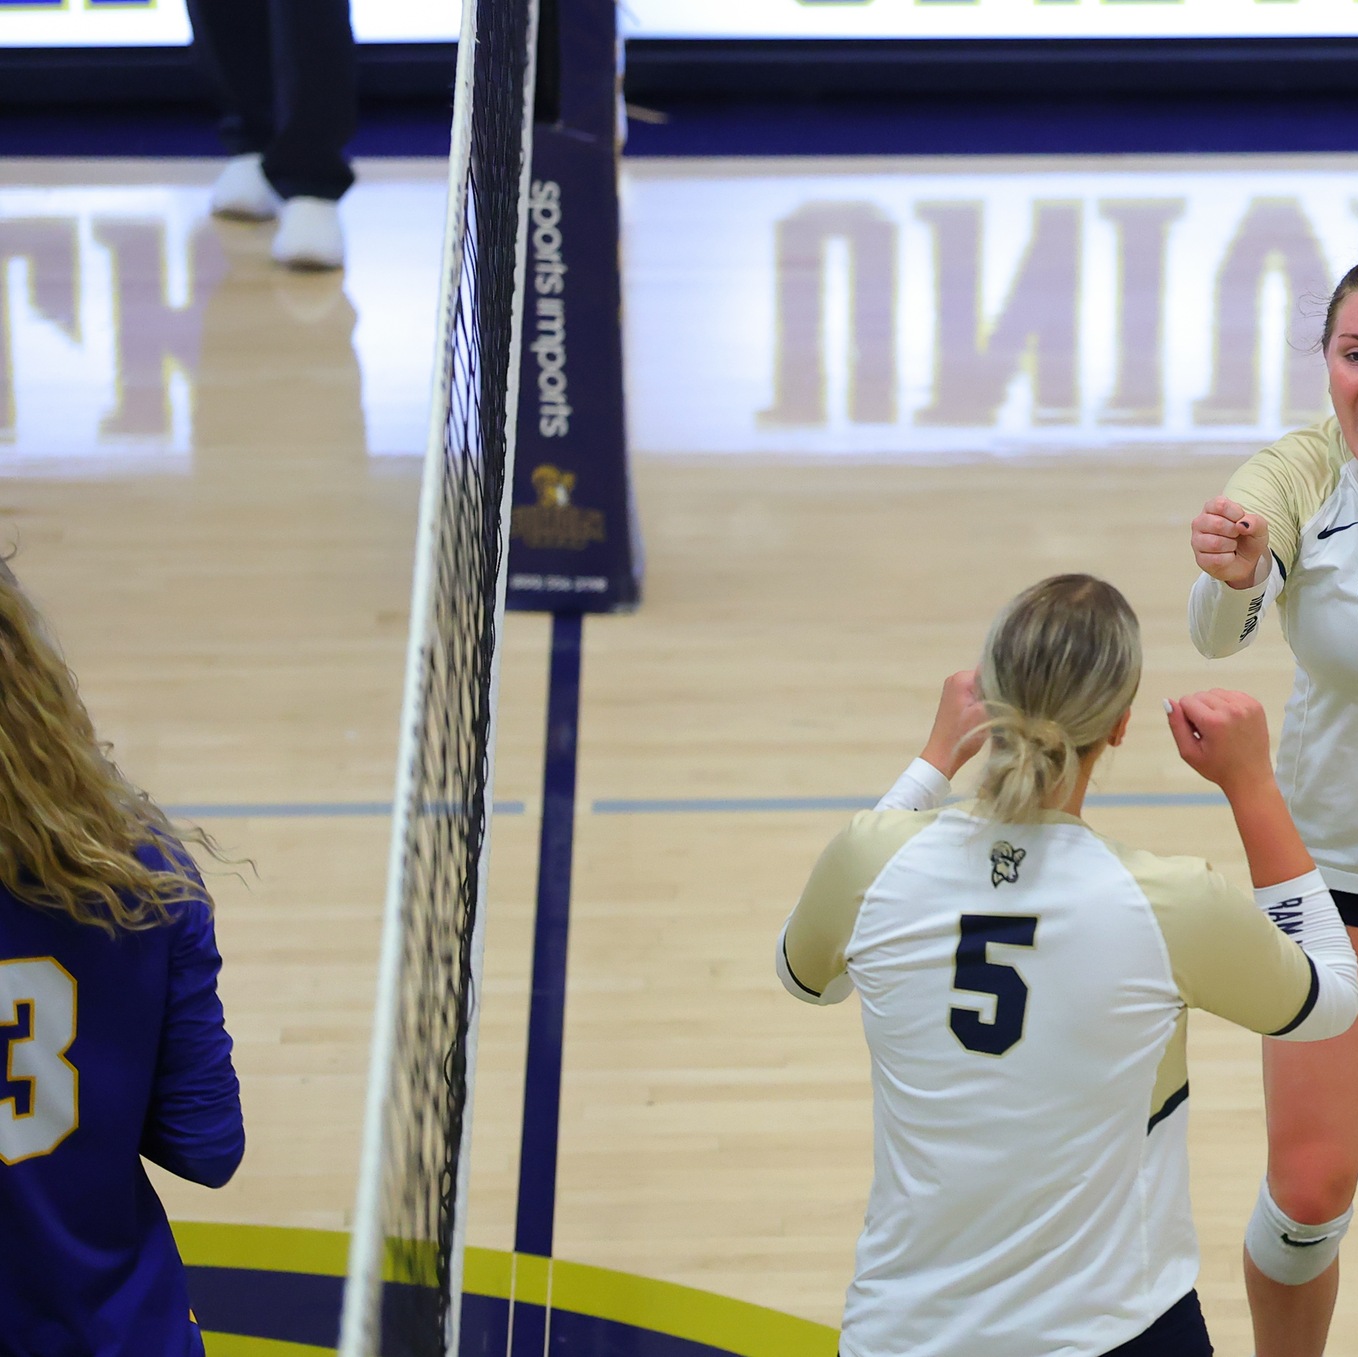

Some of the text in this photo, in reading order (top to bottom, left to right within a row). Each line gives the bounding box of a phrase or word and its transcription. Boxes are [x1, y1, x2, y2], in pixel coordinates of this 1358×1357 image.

[529, 179, 573, 438] sports imports
[948, 912, 1041, 1058] 5
